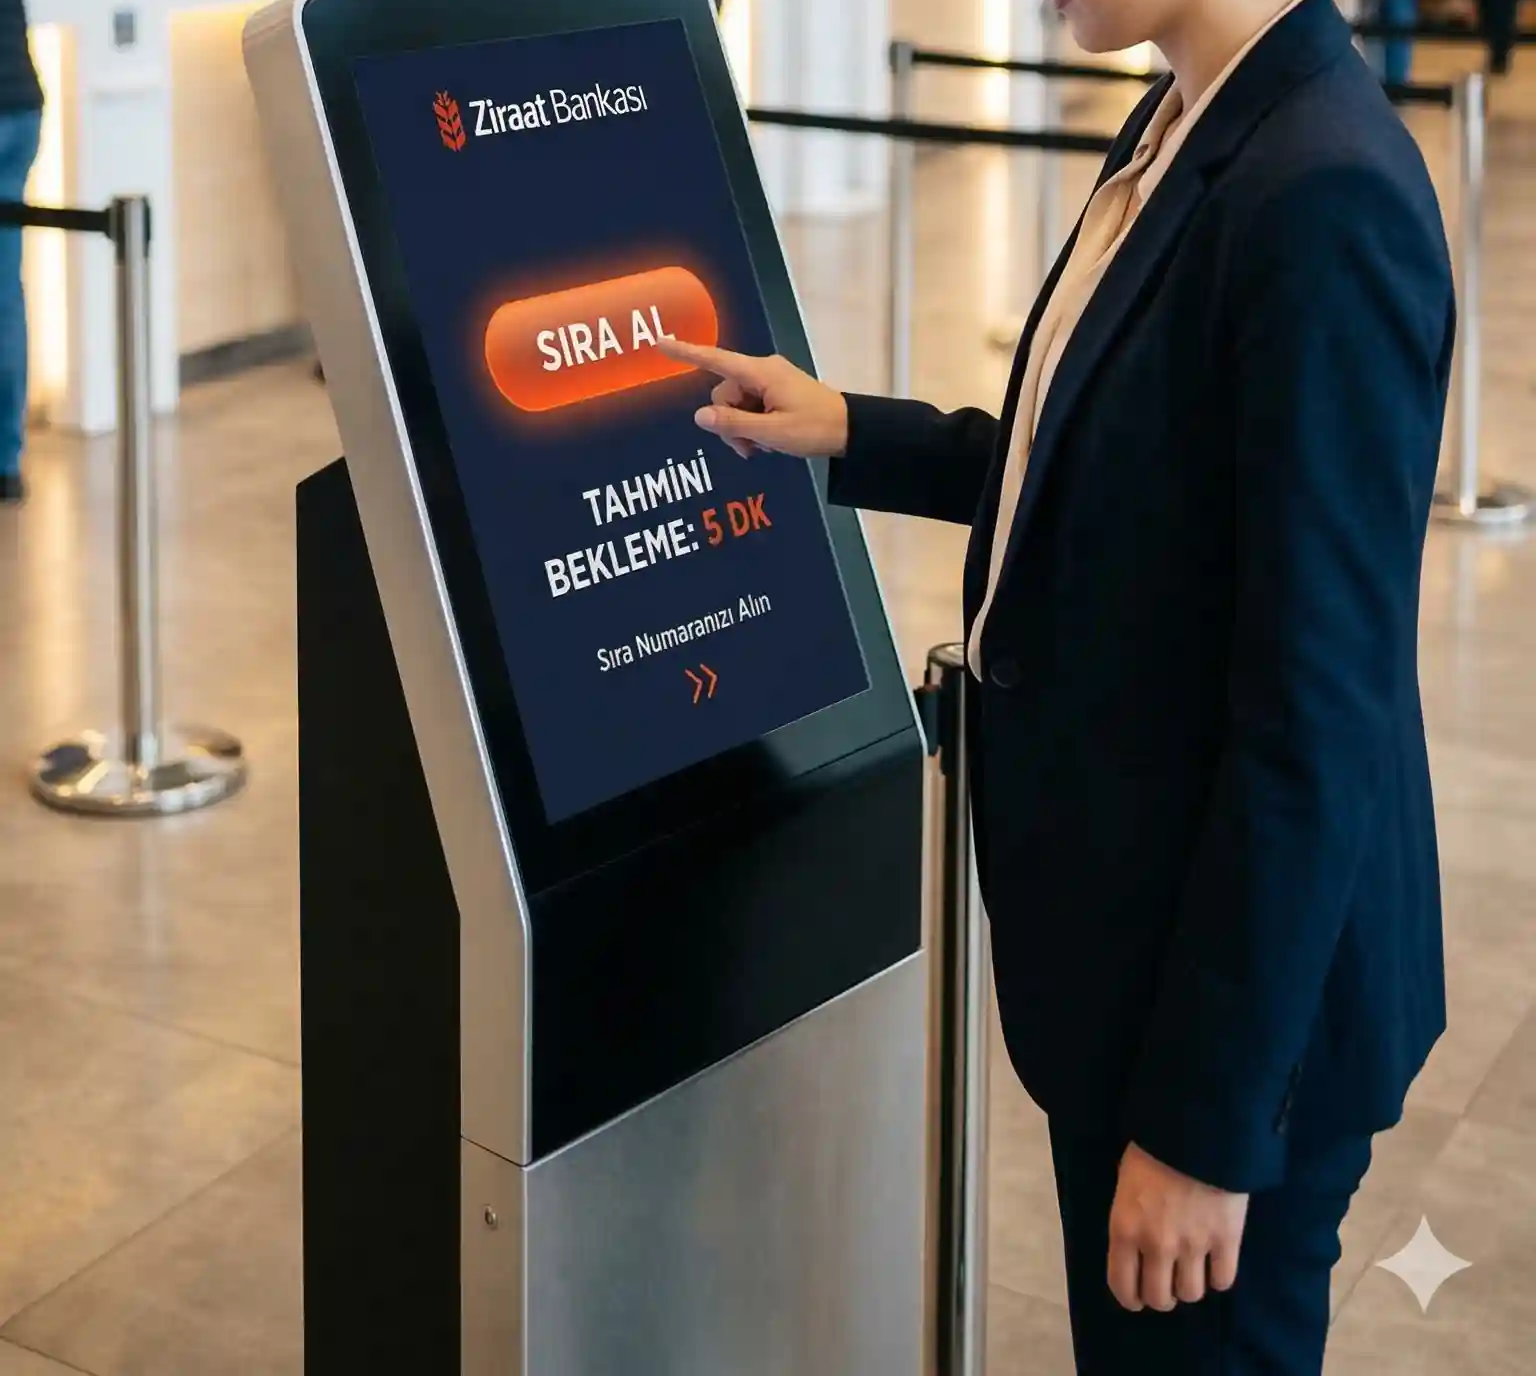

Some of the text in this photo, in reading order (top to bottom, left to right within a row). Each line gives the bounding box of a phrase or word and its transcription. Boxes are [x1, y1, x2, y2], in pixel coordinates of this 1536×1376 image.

[469, 83, 648, 136] Ziraat Bankası
[536, 305, 677, 372] SIRA AL
[583, 449, 713, 526] TAHMİNİ
[544, 493, 772, 597] BEKLEME: 5 DK
[597, 594, 772, 672] Sıra Numaranızı Alın
